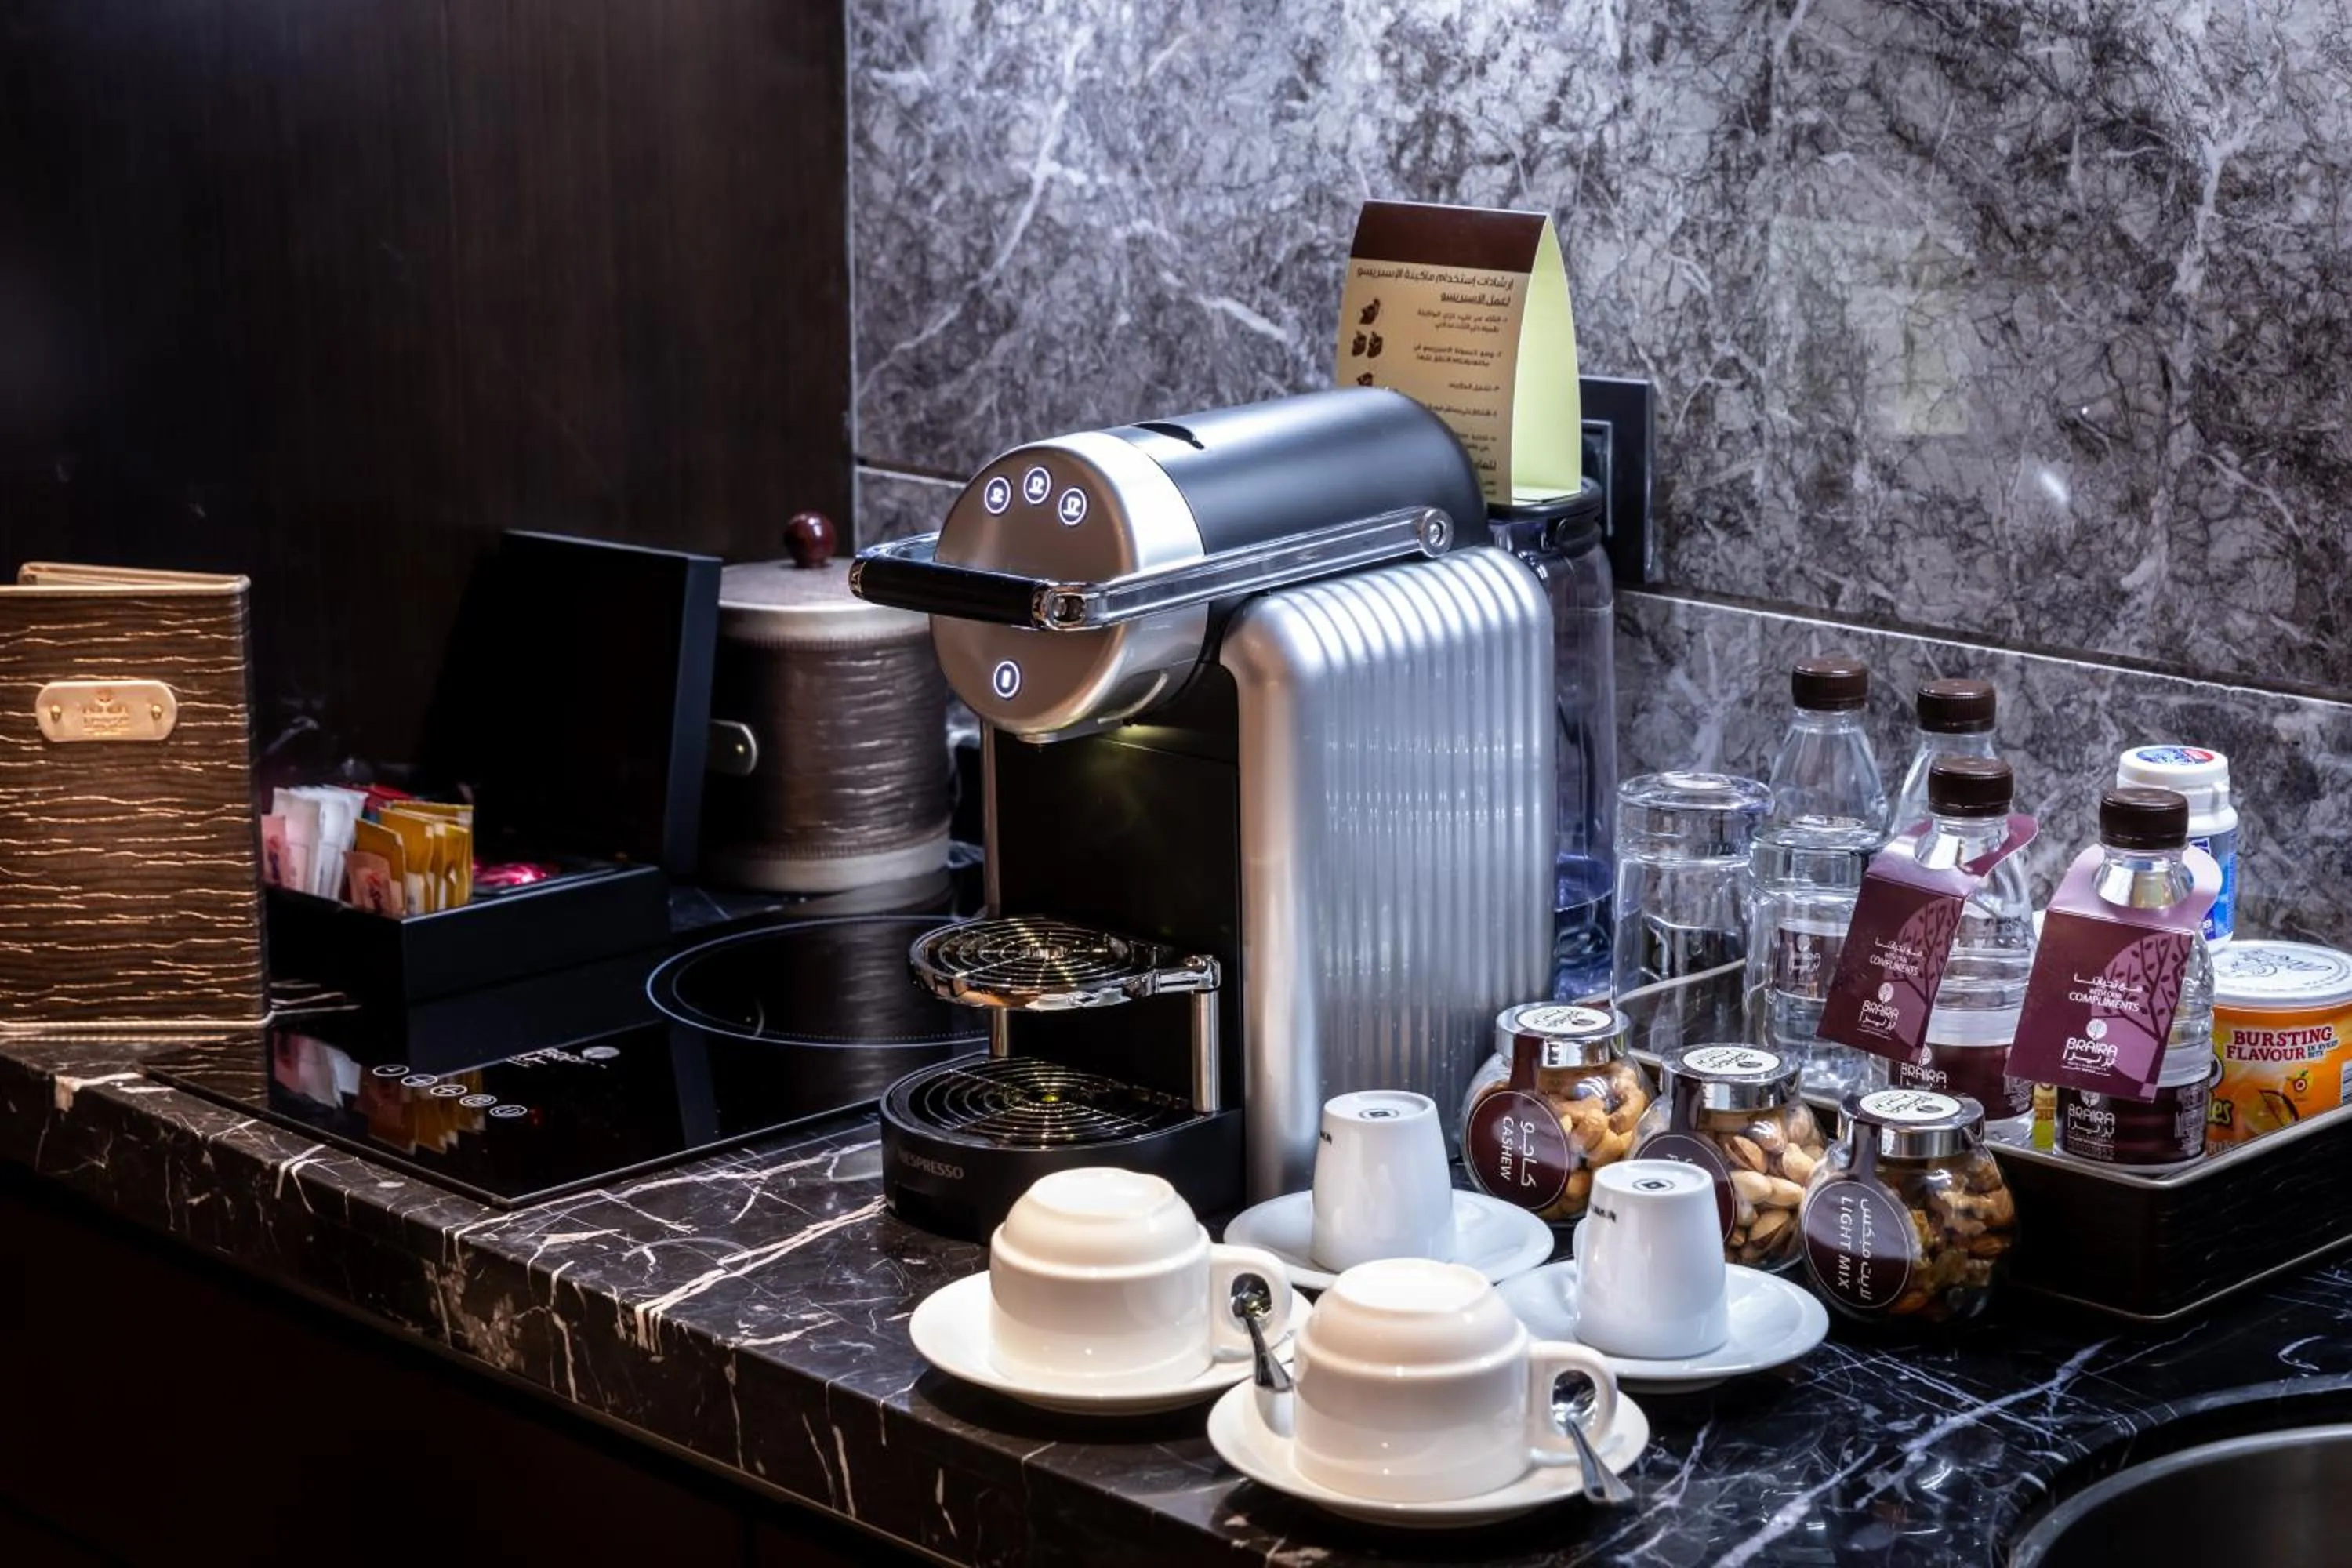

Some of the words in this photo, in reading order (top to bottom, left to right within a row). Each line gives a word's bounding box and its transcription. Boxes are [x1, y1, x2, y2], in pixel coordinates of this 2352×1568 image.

[1862, 1000, 1899, 1020] BRAIRA
[2069, 991, 2140, 1012] COMPLIMENTS
[2066, 1037, 2118, 1057] BRAIRA
[2233, 1026, 2332, 1047] BURSTING
[2227, 1045, 2305, 1062] FLAVOUR
[1901, 1062, 1947, 1083] BRAIRA
[2067, 1103, 2115, 1126] BRAIRA
[1500, 1116, 1514, 1181] CASHEW
[1840, 1196, 1853, 1250] LIGHT
[1838, 1254, 1851, 1290] MIX
